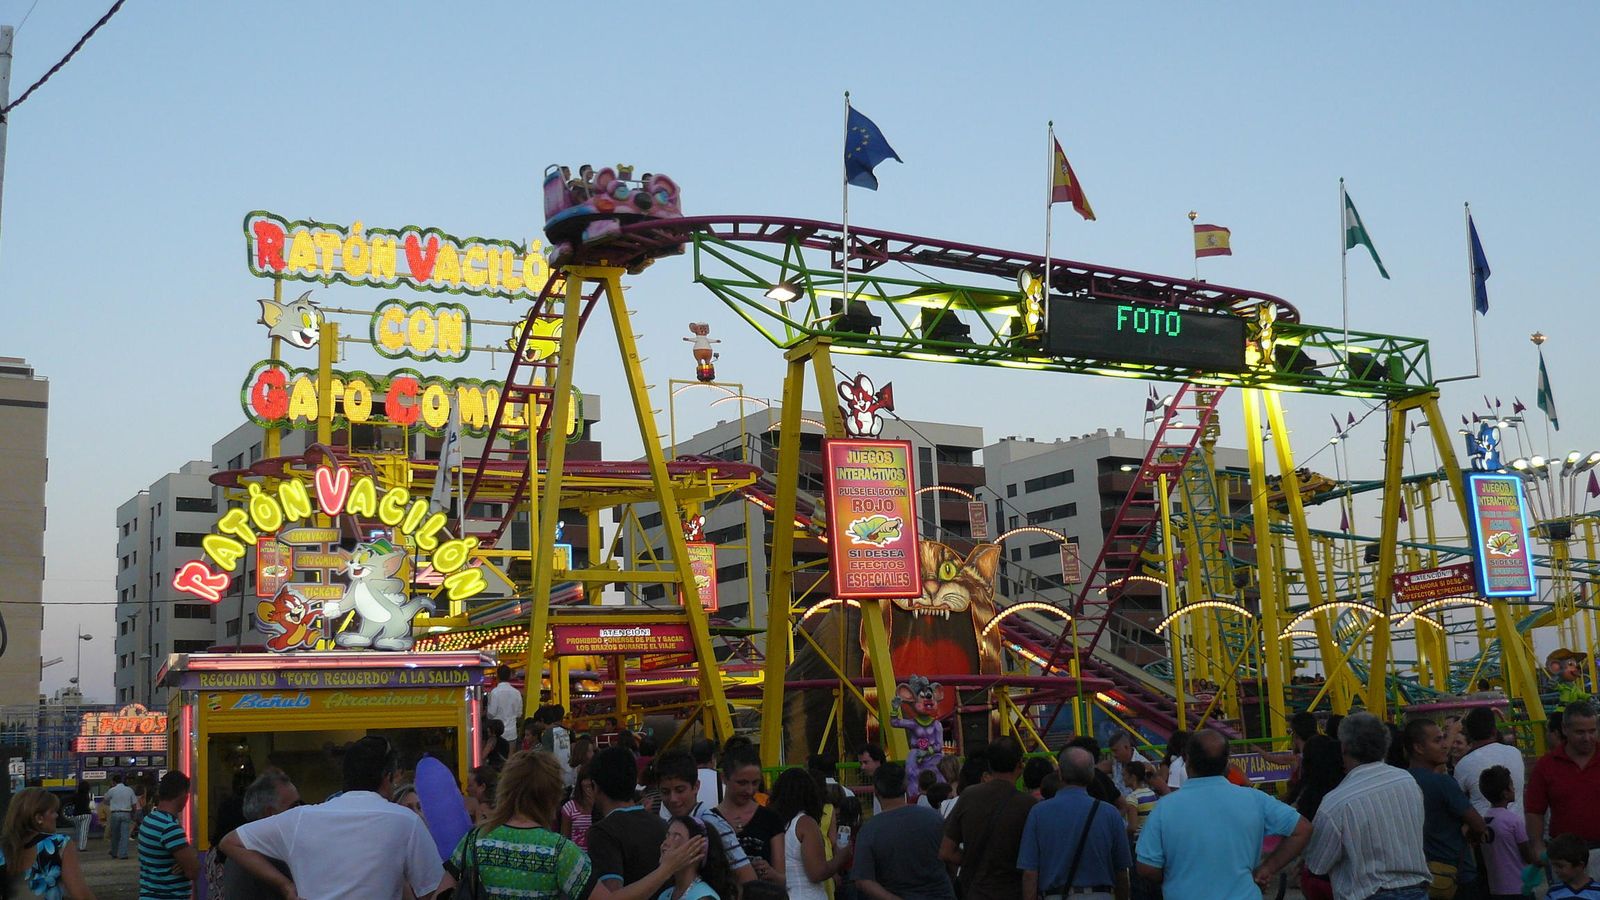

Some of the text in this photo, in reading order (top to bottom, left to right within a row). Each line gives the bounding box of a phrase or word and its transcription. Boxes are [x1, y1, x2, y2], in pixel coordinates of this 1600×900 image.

[253, 220, 396, 279] RATÓN
[1117, 305, 1181, 336] FOTO
[379, 308, 462, 353] CON
[252, 368, 373, 421] GATO
[847, 451, 893, 464] JUEGOS
[836, 467, 905, 481] INTERACTIVOS
[839, 487, 864, 496] PULSE
[866, 487, 876, 496] EL
[1482, 482, 1510, 493] JUEGOS
[852, 499, 895, 512] ROJO
[172, 465, 488, 602] RATÓN VACILÓN
[849, 550, 904, 558] SI DESEA
[850, 561, 905, 569] EFECTOS
[848, 573, 910, 587] ESPECIALES
[304, 586, 342, 597] TICKETS
[591, 643, 617, 651] BRAZOS
[619, 642, 648, 650] DURANTE
[200, 672, 256, 687] RECOJAN
[260, 671, 276, 686] SU
[399, 670, 408, 684] A
[410, 670, 425, 684] LA
[428, 670, 470, 683] SALIDA
[323, 691, 428, 709] Atracciones
[100, 717, 167, 734] FOTOS
